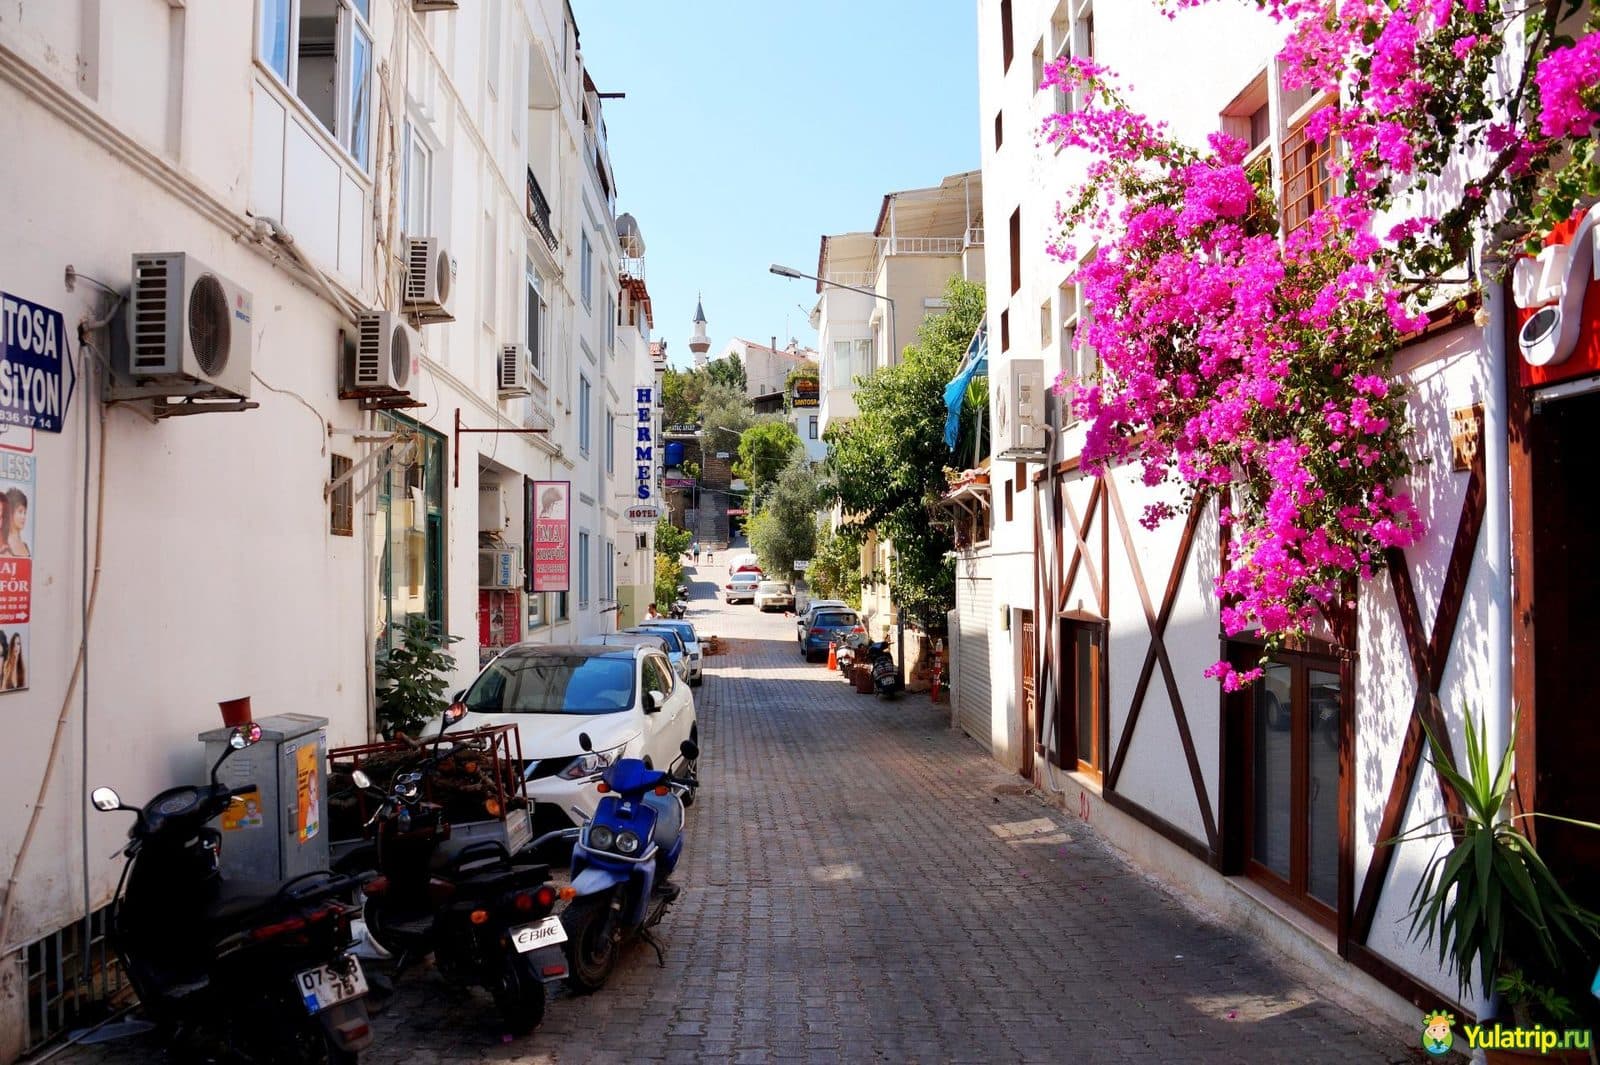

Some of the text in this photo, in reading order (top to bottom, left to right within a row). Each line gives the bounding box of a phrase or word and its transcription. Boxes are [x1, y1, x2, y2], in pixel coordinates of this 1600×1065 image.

[23, 414, 36, 426] 17
[40, 417, 51, 429] 14
[635, 388, 652, 499] HERMES
[629, 509, 658, 518] HOTEL
[530, 925, 558, 941] BIKE
[302, 969, 322, 990] 07
